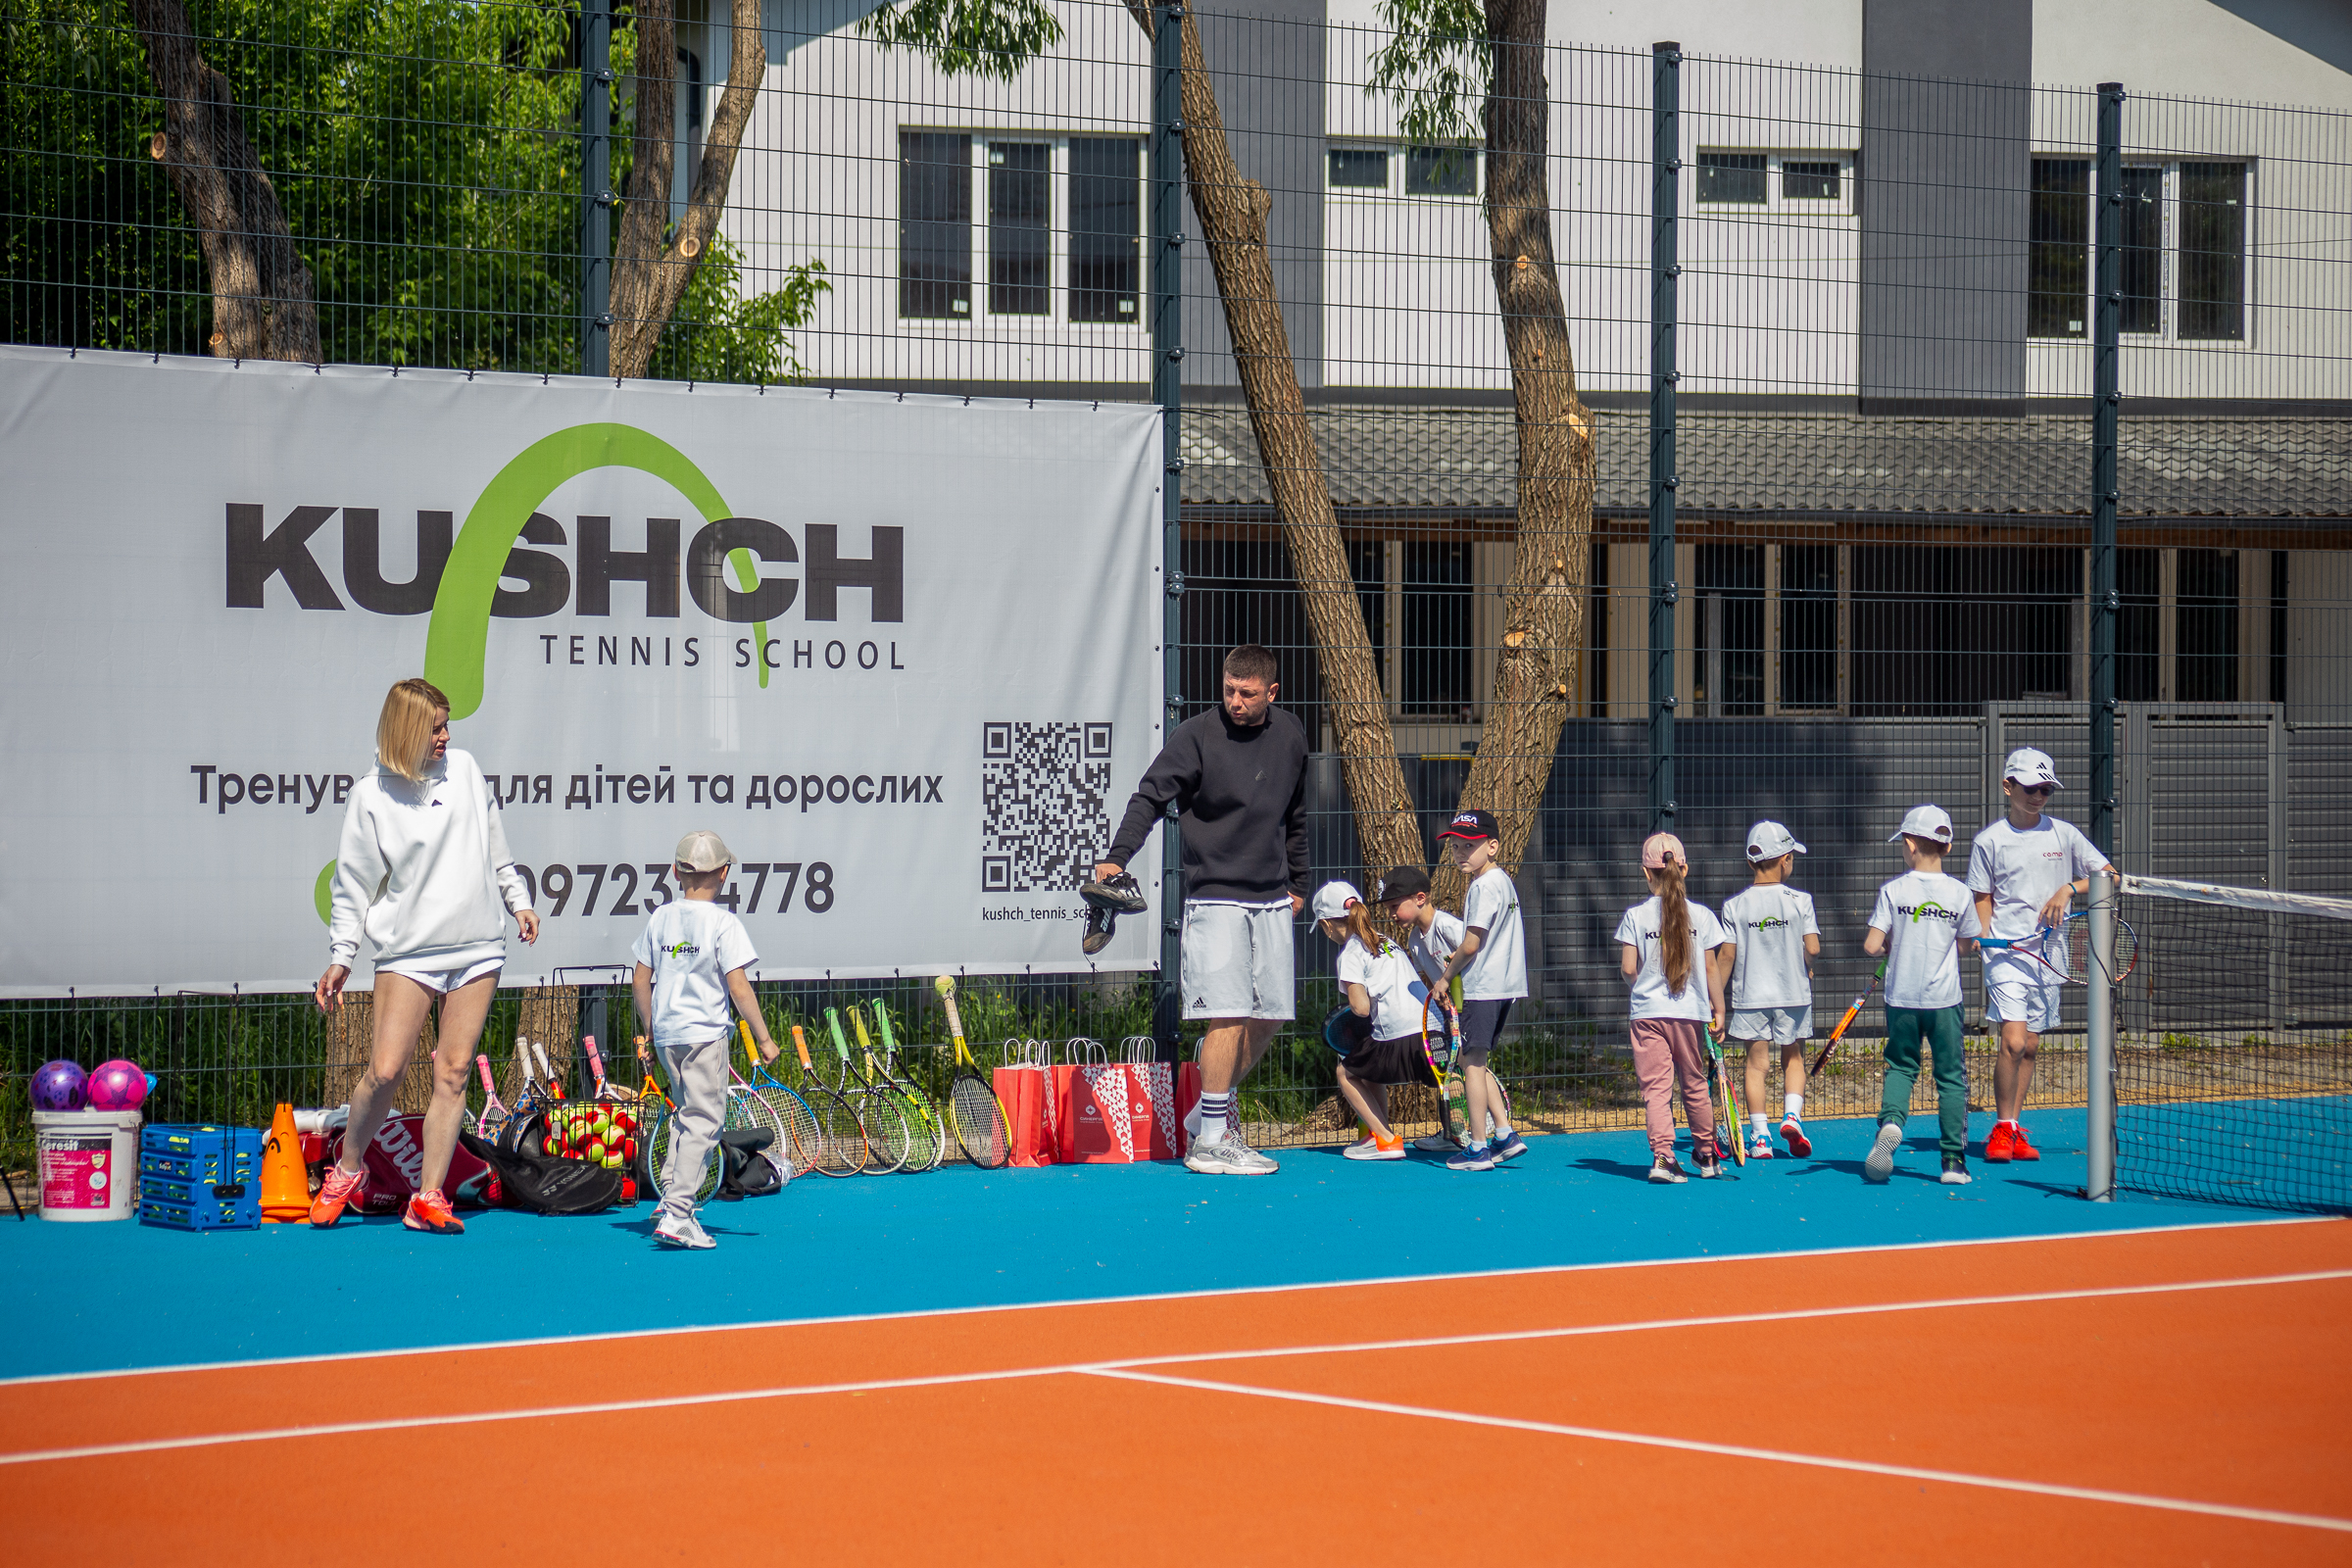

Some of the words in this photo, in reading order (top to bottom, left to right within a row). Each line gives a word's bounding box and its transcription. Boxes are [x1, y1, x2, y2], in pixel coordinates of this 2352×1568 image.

[225, 502, 905, 623] KUSHCH
[540, 634, 701, 666] TENNIS
[735, 638, 906, 670] SCHOOL
[190, 764, 355, 814] Тренув
[483, 774, 553, 810] для
[564, 763, 675, 810] дітей
[688, 773, 736, 804] та
[746, 772, 944, 813] дорослих
[1451, 814, 1477, 825] NASA
[505, 860, 835, 917] 097234778
[982, 906, 1085, 922] kushch_tennis_sc
[1897, 906, 1959, 921] KUSHCH
[1748, 919, 1788, 929] KUSHCH
[1645, 928, 1697, 940] KUH
[661, 945, 701, 954] KUSHCH
[42, 1139, 79, 1152] Ceresit
[373, 1121, 422, 1189] Wils
